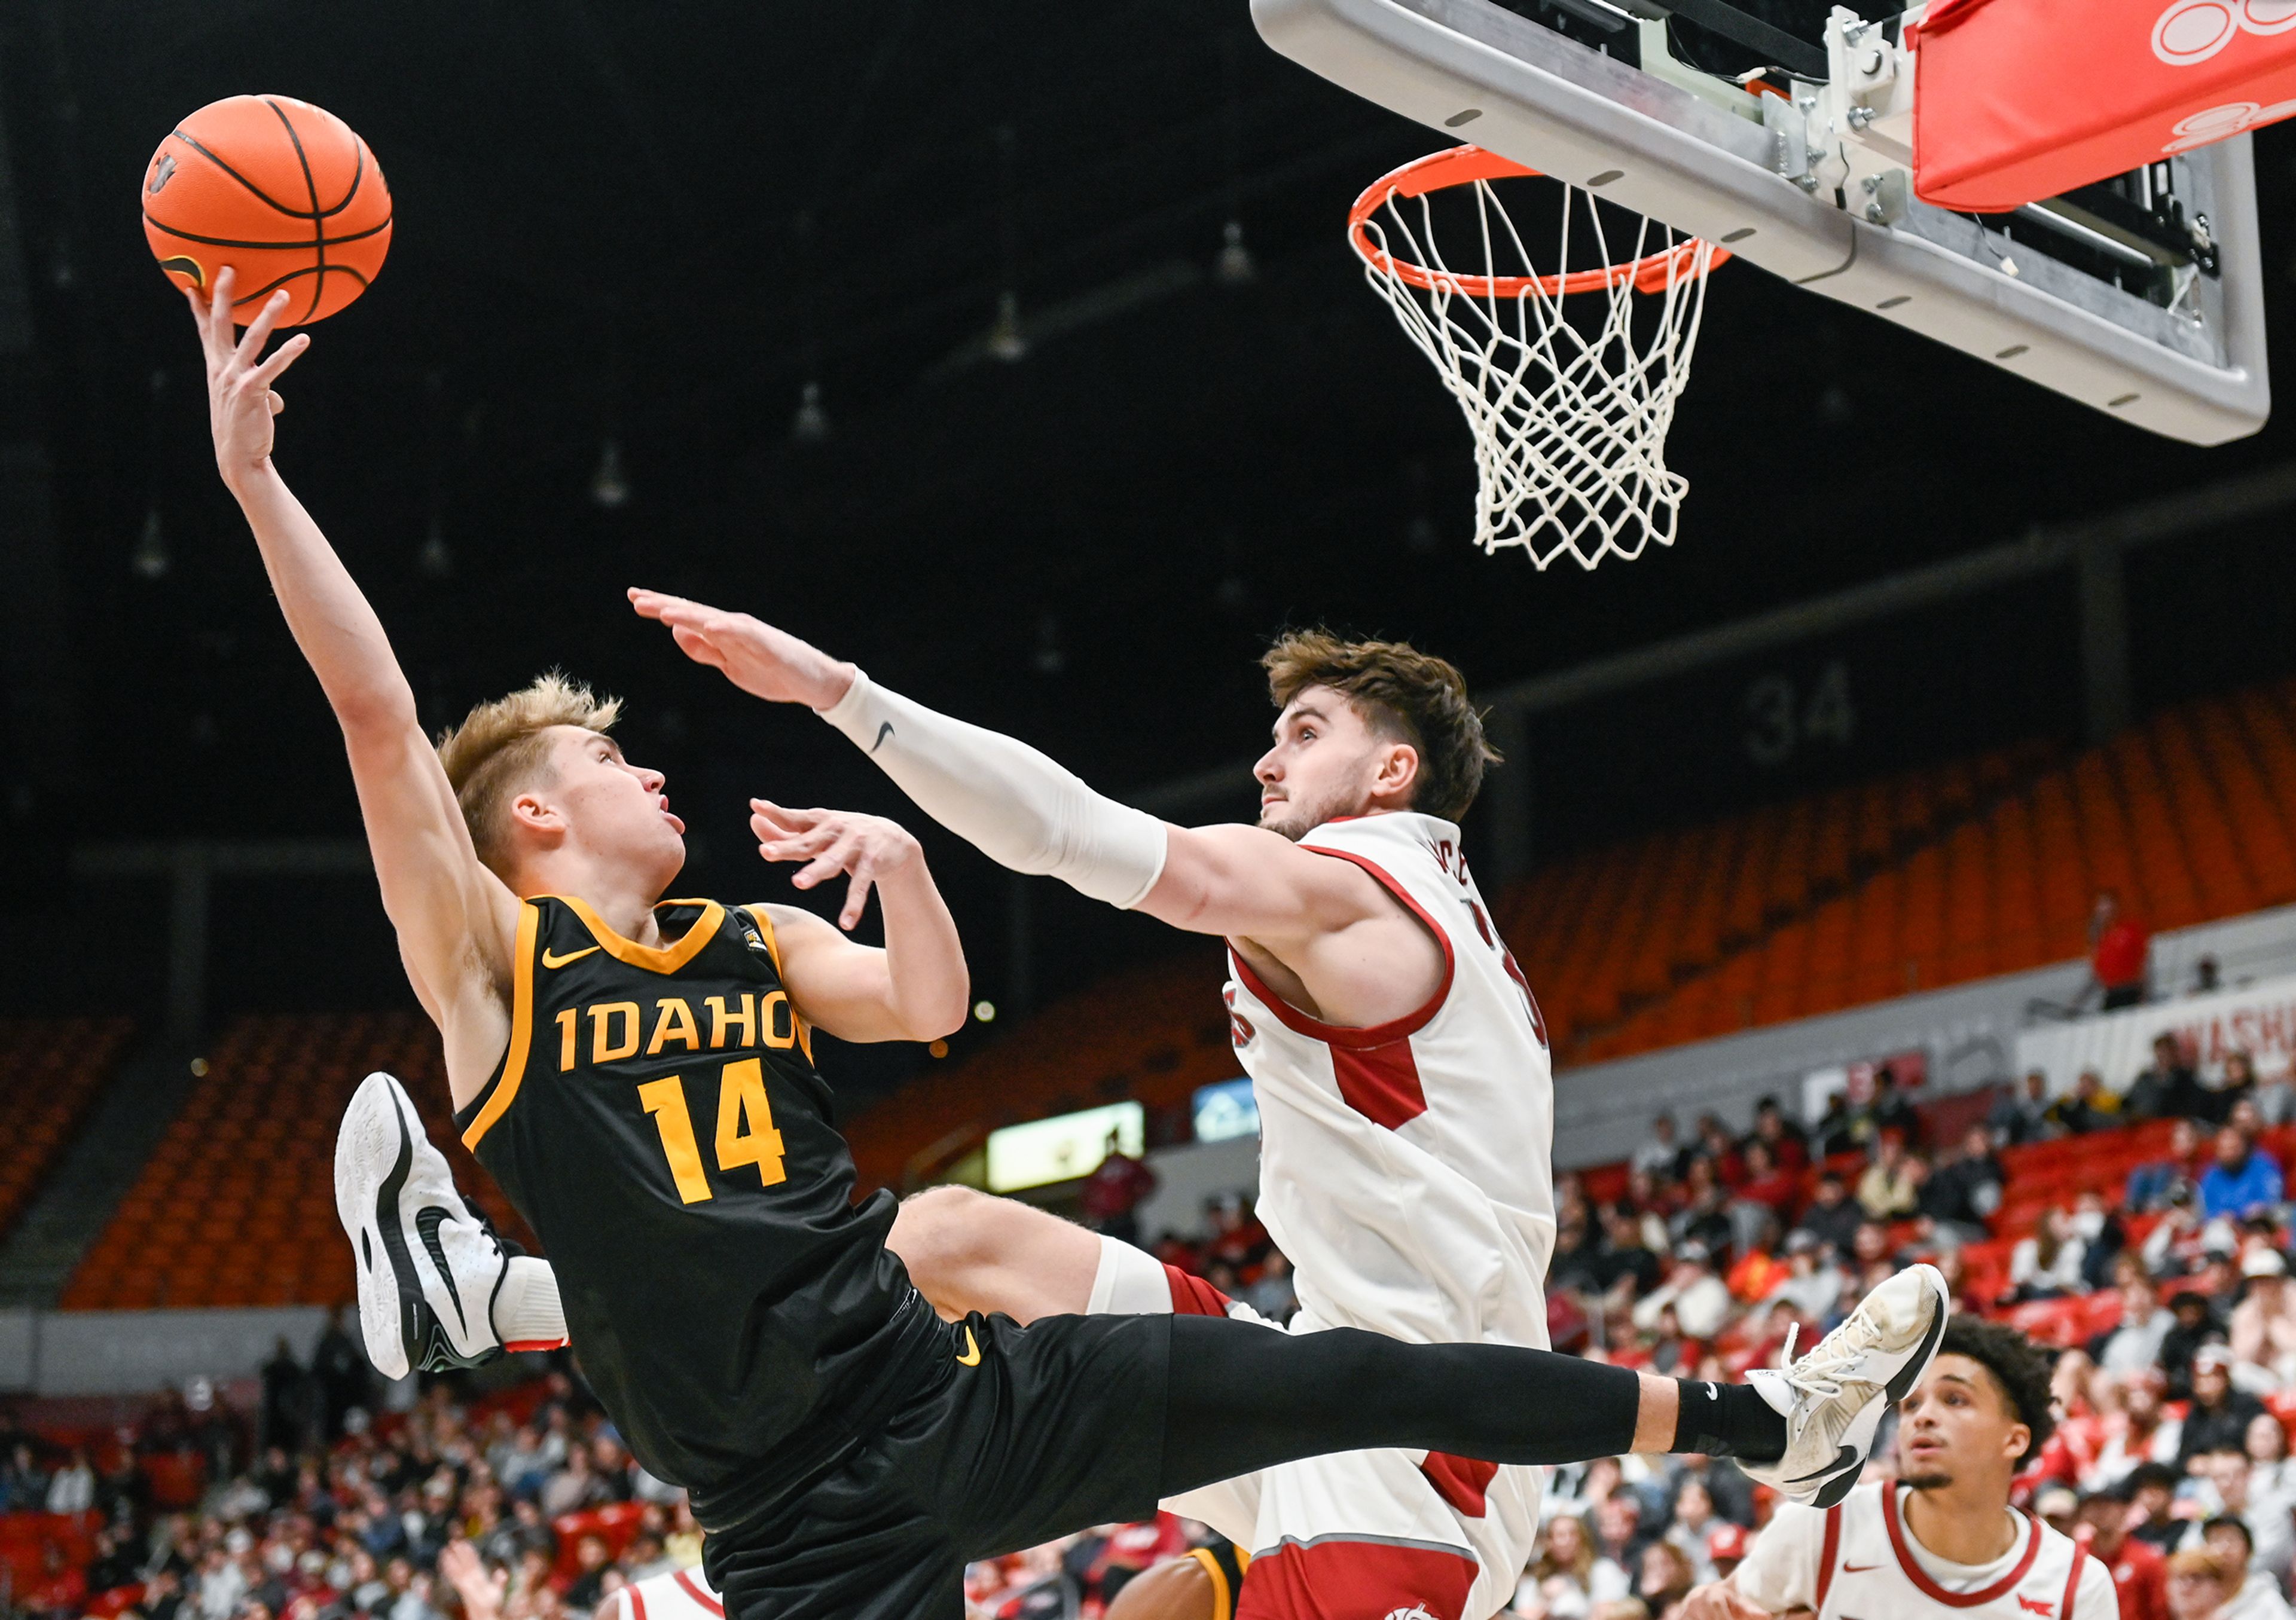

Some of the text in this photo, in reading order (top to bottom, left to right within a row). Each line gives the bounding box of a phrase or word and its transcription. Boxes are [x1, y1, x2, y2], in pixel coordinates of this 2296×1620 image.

[1744, 662, 1855, 764] 34
[555, 990, 796, 1072] IDAHO
[637, 1057, 787, 1205] 14
